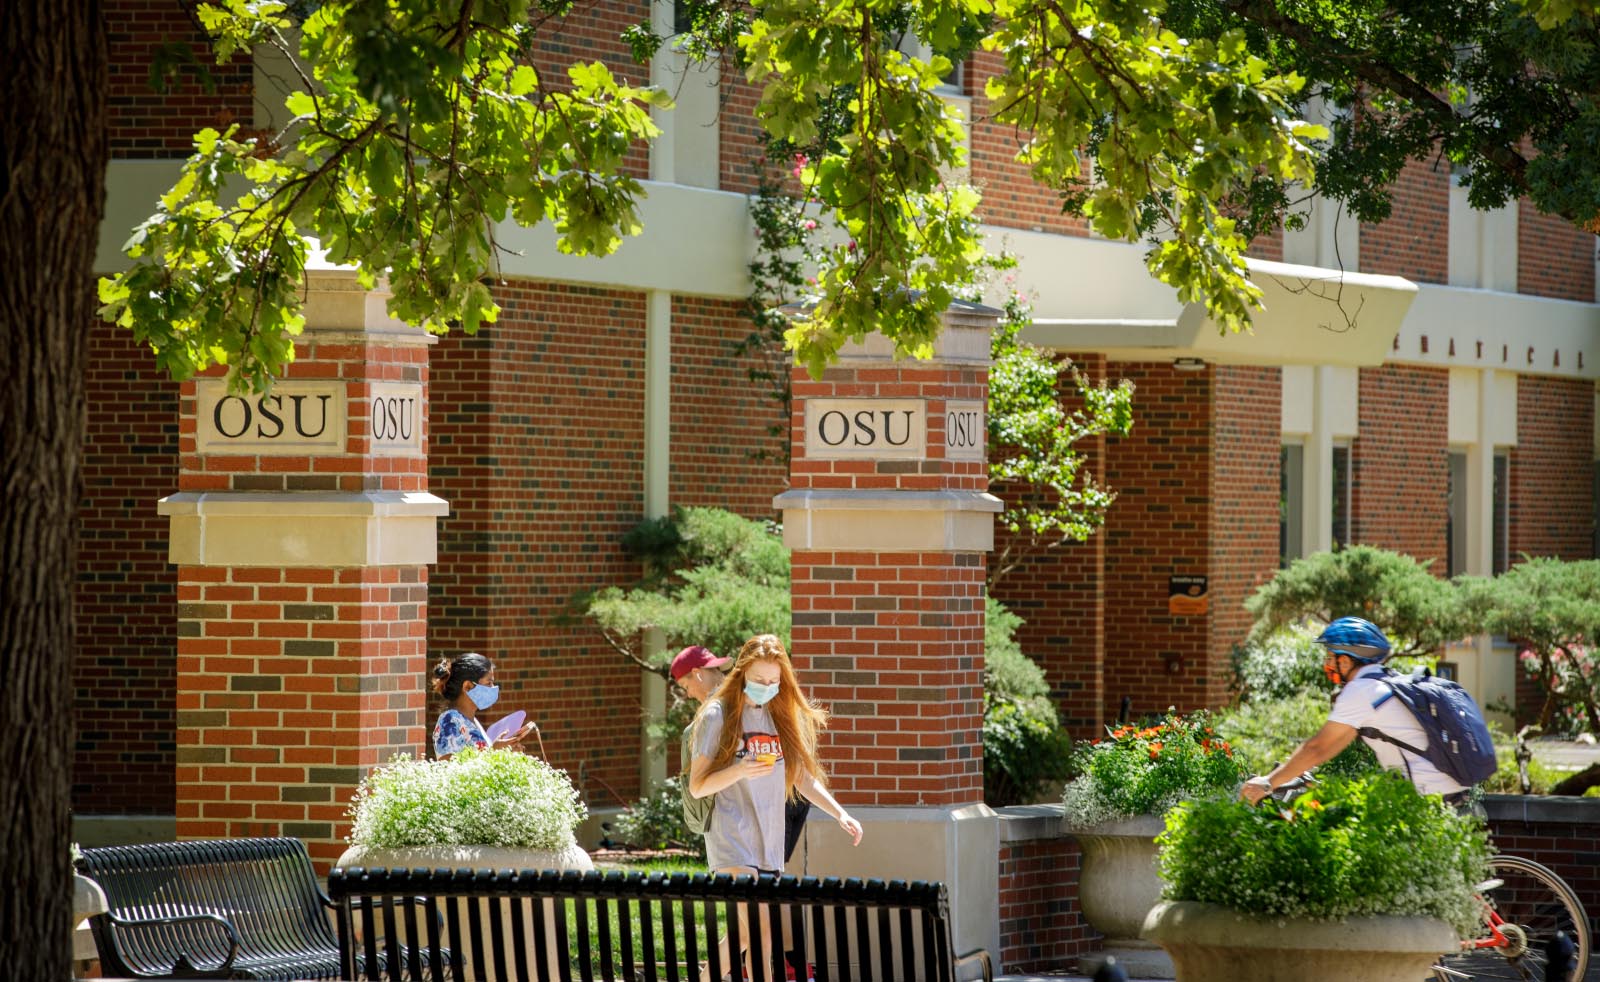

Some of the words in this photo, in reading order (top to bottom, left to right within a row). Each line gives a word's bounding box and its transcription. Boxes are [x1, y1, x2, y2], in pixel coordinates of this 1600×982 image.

[213, 394, 332, 438] OSU
[372, 396, 413, 440] OSU
[818, 410, 915, 446] OSU
[947, 411, 977, 447] OSU
